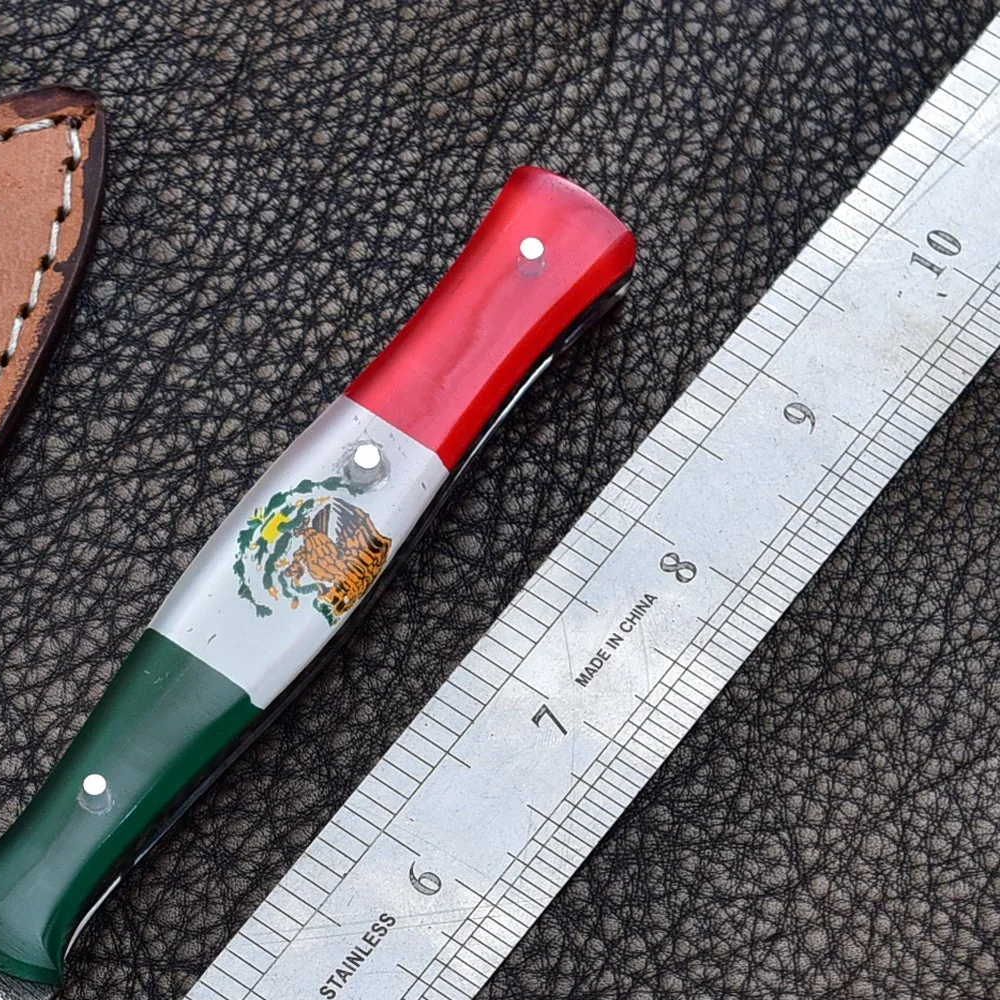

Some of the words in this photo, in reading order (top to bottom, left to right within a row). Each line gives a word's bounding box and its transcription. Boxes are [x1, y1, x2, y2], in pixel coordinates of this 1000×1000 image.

[910, 229, 962, 278] 10
[783, 402, 816, 435] 9
[659, 552, 698, 584] 8
[574, 651, 611, 688] MADE
[605, 633, 625, 653] IN
[619, 593, 658, 632] CHINA
[531, 703, 568, 736] 7
[409, 860, 442, 896] 6
[319, 913, 396, 1000] STAINLESS
